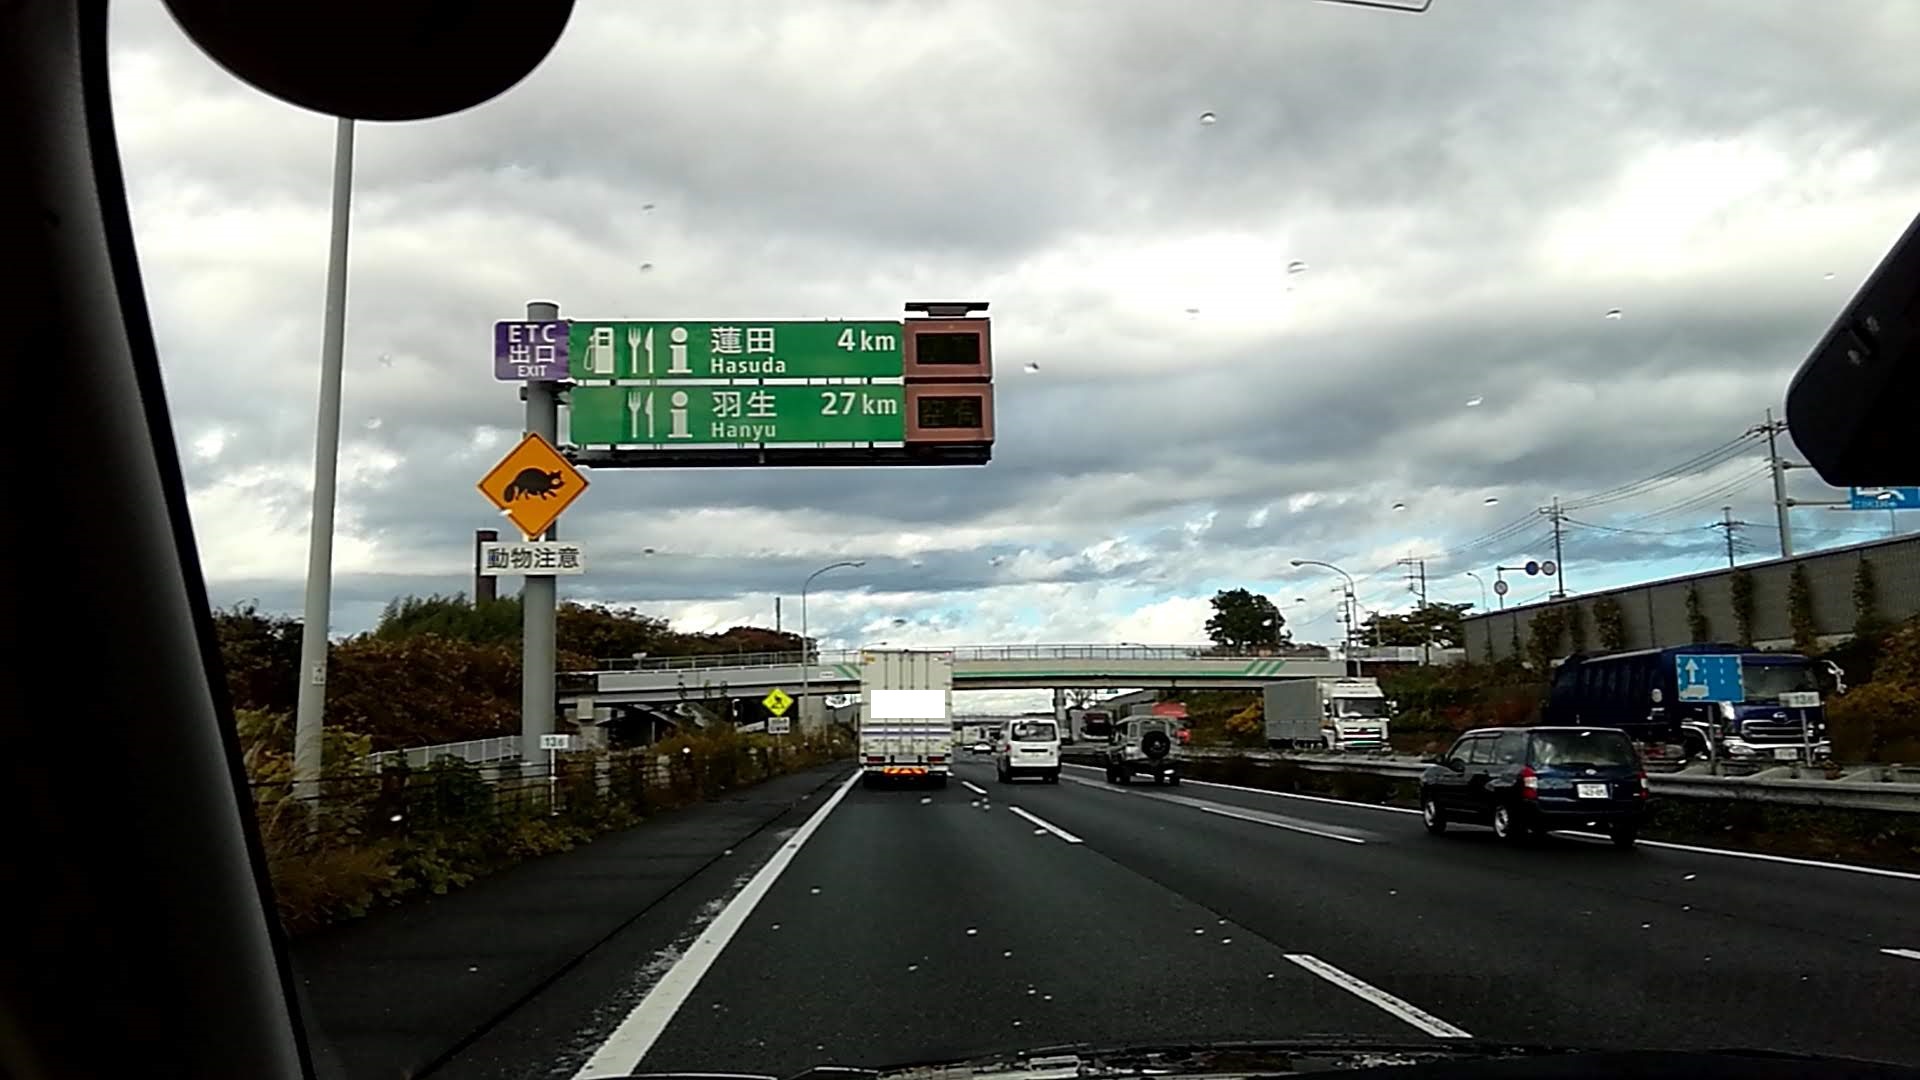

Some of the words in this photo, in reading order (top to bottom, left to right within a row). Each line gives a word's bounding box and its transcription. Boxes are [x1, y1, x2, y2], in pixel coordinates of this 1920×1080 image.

[508, 325, 556, 343] ETC
[711, 327, 775, 354] 蓮田
[509, 345, 556, 363] 出口
[518, 365, 547, 377] EXIT
[710, 357, 786, 374] Hasuda
[712, 391, 777, 418] 羽生
[711, 422, 776, 441] Hanyu
[487, 547, 579, 569] 動物注意
